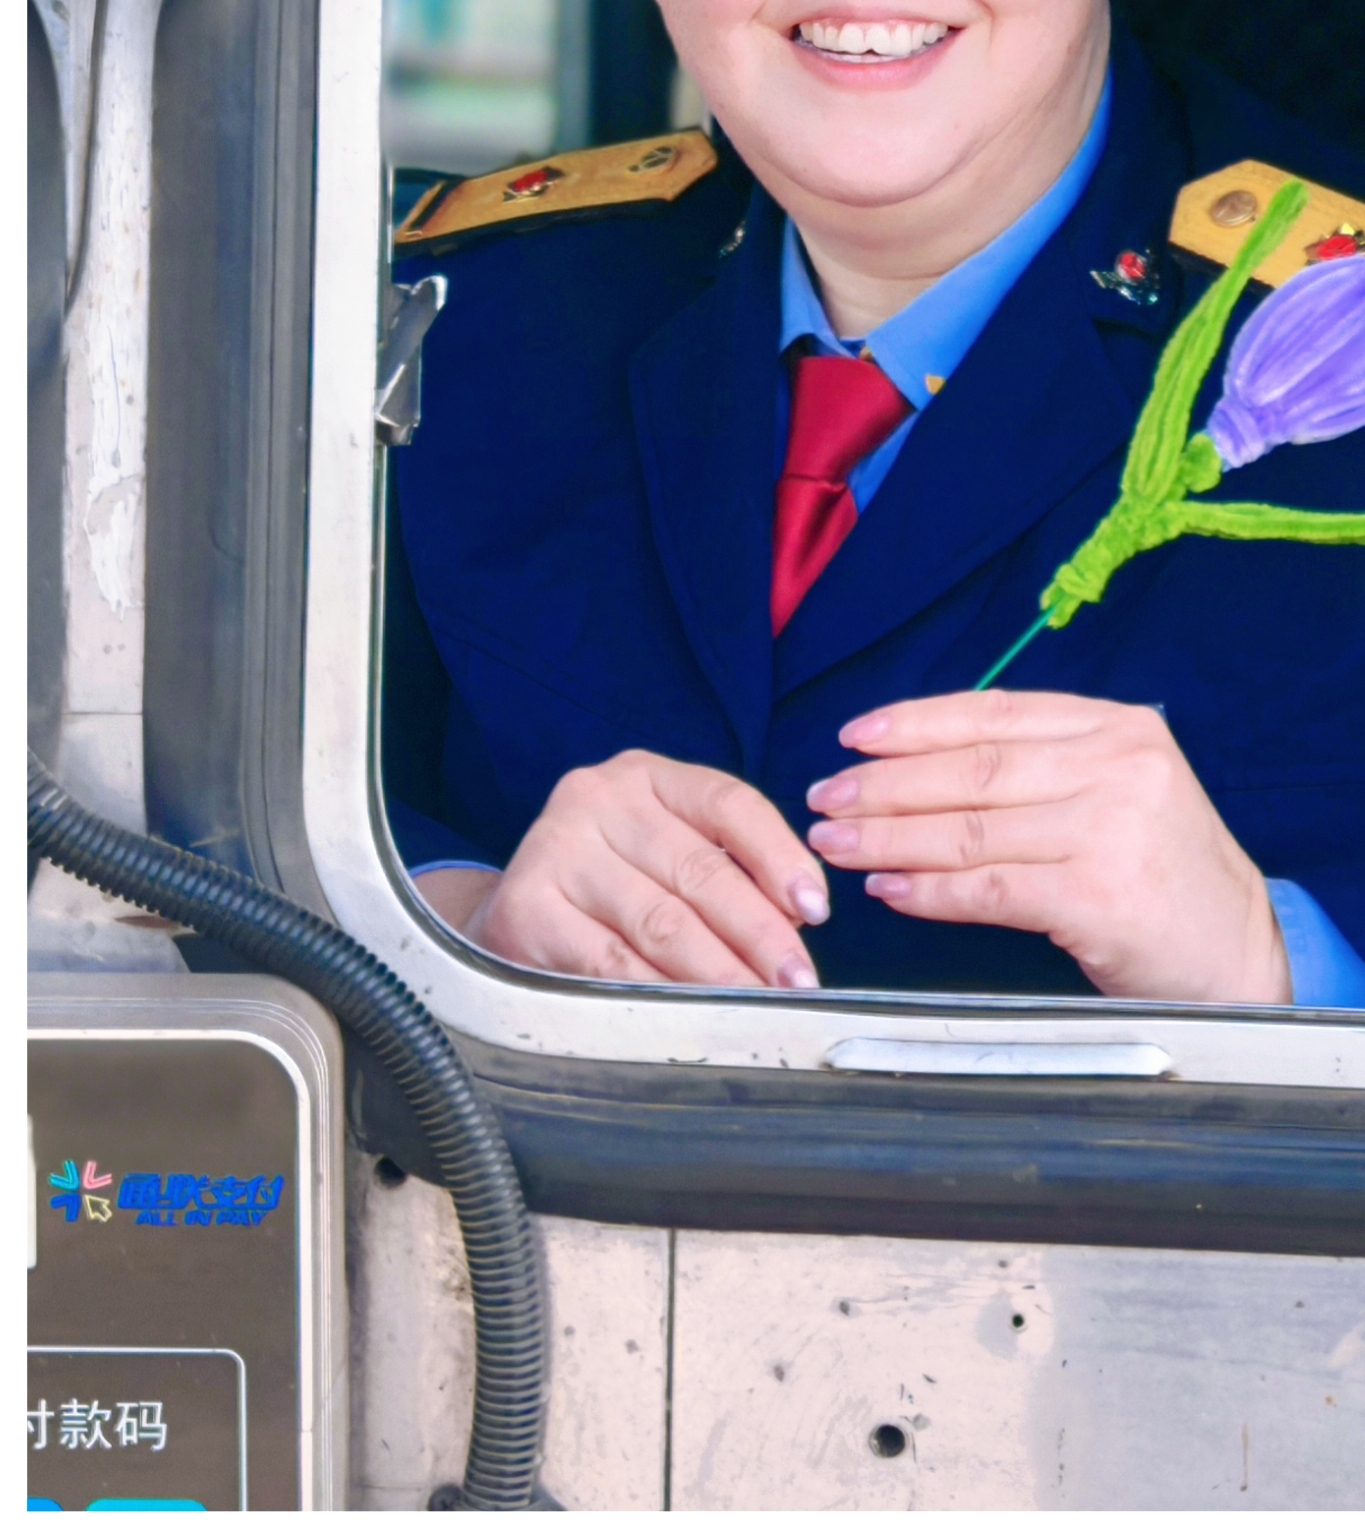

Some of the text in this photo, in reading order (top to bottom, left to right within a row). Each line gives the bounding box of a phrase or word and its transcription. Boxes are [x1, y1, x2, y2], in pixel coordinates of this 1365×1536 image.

[135, 1210, 268, 1227] ALL IN PAY
